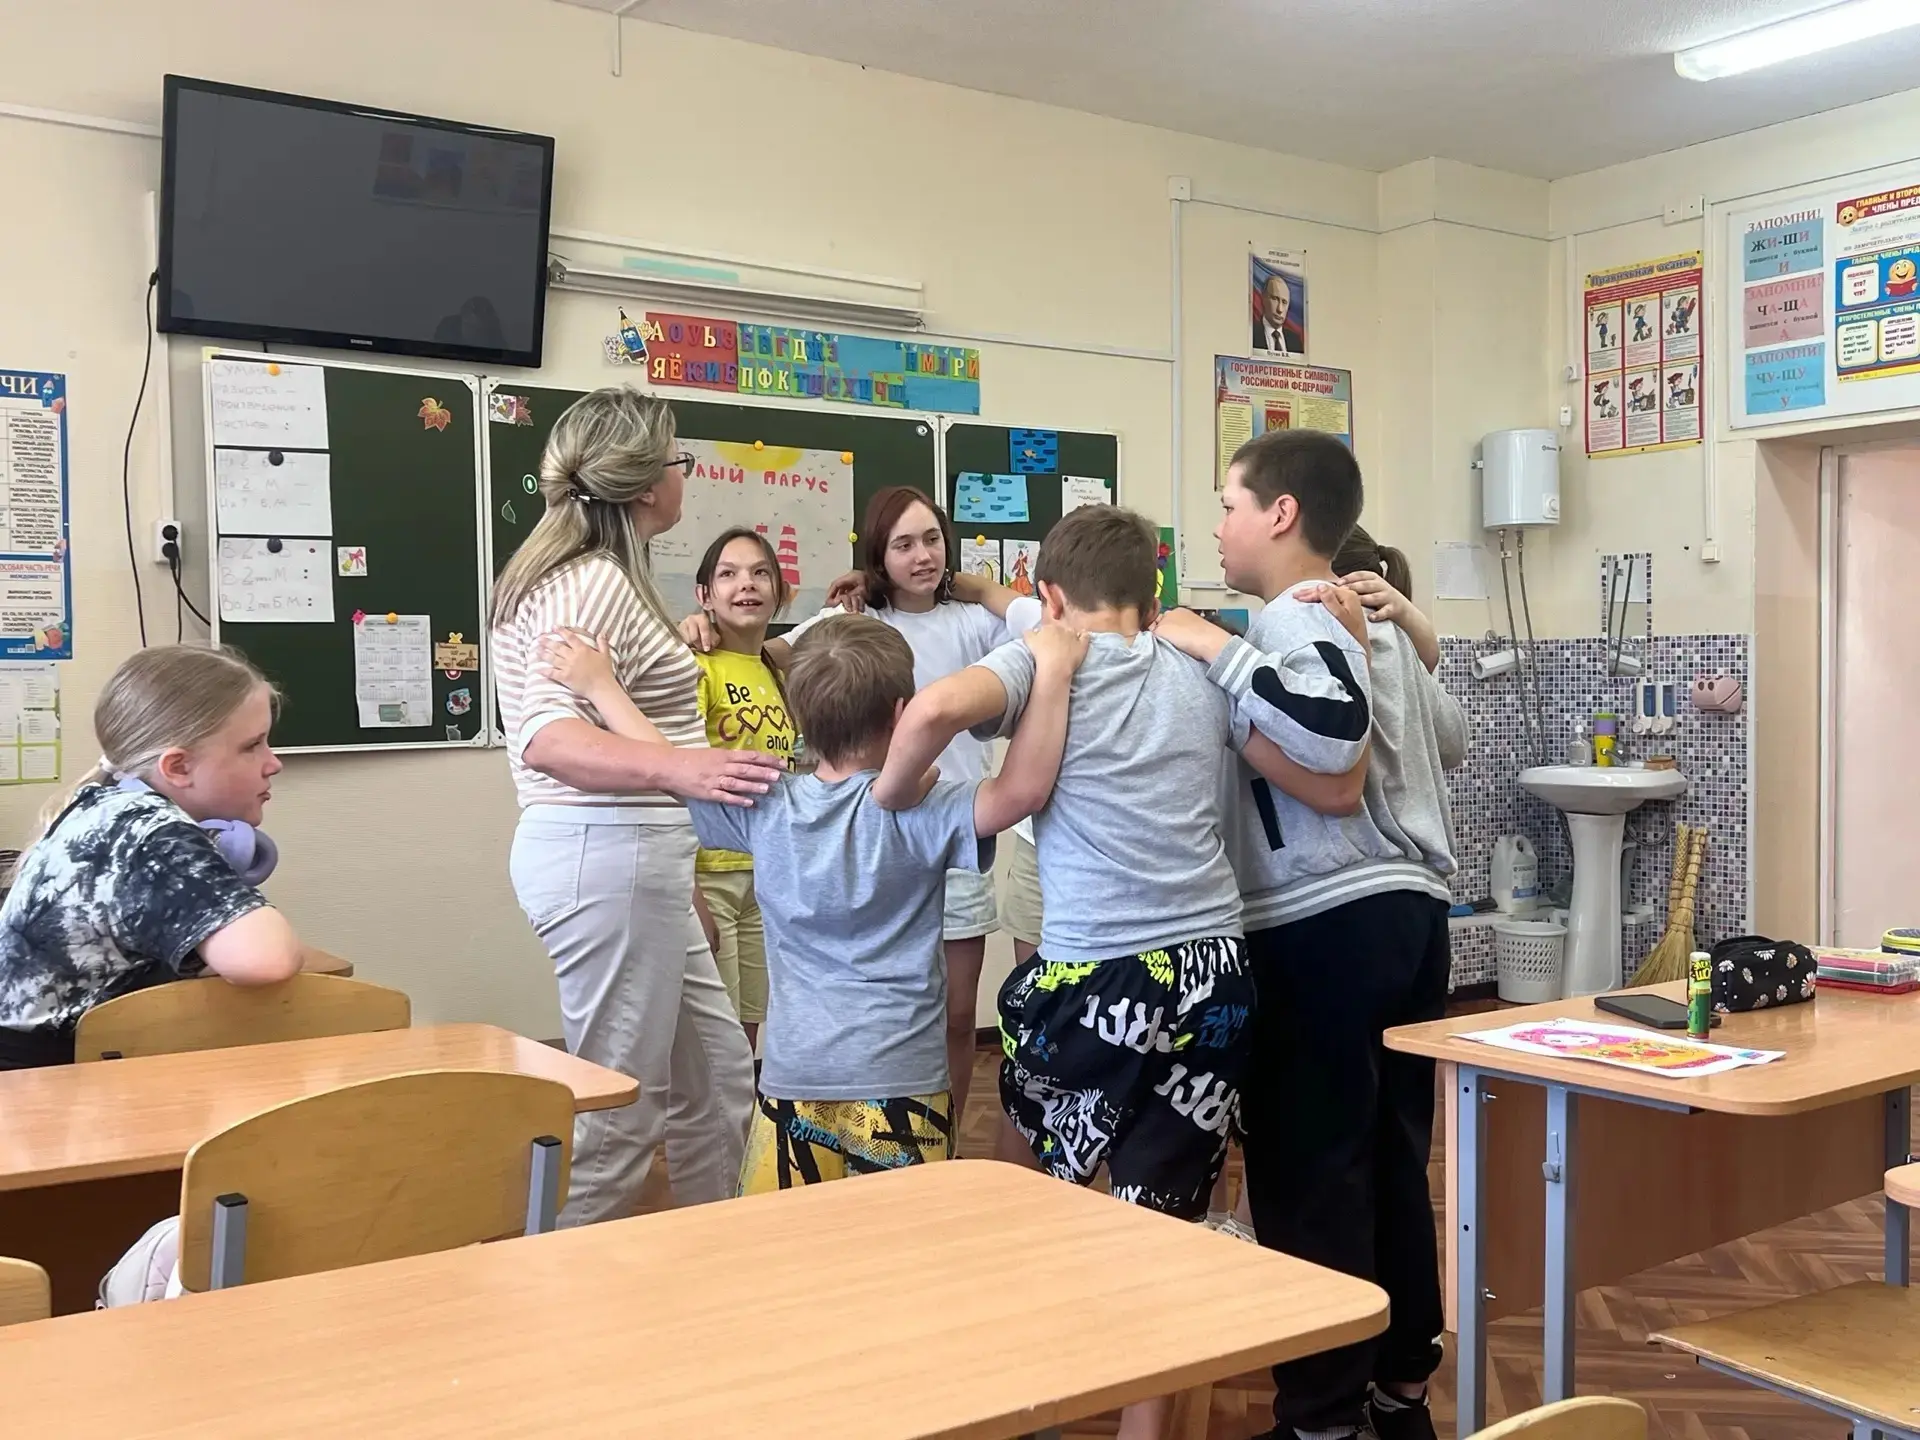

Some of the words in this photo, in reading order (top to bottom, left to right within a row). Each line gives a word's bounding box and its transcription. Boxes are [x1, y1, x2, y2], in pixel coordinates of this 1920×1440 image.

[1871, 201, 1899, 214] ЧЛЕНЫ
[1748, 208, 1821, 233] ЗАПОМНИ!
[1751, 230, 1810, 252] ЖИ-ШИ
[1779, 260, 1789, 273] И
[1747, 274, 1824, 300] ЗАПОМНИ!
[1757, 298, 1808, 316] ЧА-ЩА
[1780, 329, 1789, 340] А
[1230, 362, 1303, 379] ГОСУДАРСТВЕННЫЕ
[1304, 370, 1340, 384] СИМВОЛЫ
[1757, 366, 1806, 384] ЧУ-ЩУ
[1240, 375, 1289, 390] РОССИЙСКОЙ
[1291, 380, 1334, 395] ФЕДЕРАЦИИ
[1781, 396, 1790, 407] У
[763, 470, 828, 493] ПАРУС
[725, 683, 752, 705] Be
[766, 734, 789, 751] and
[790, 1116, 840, 1150] EXTREME
